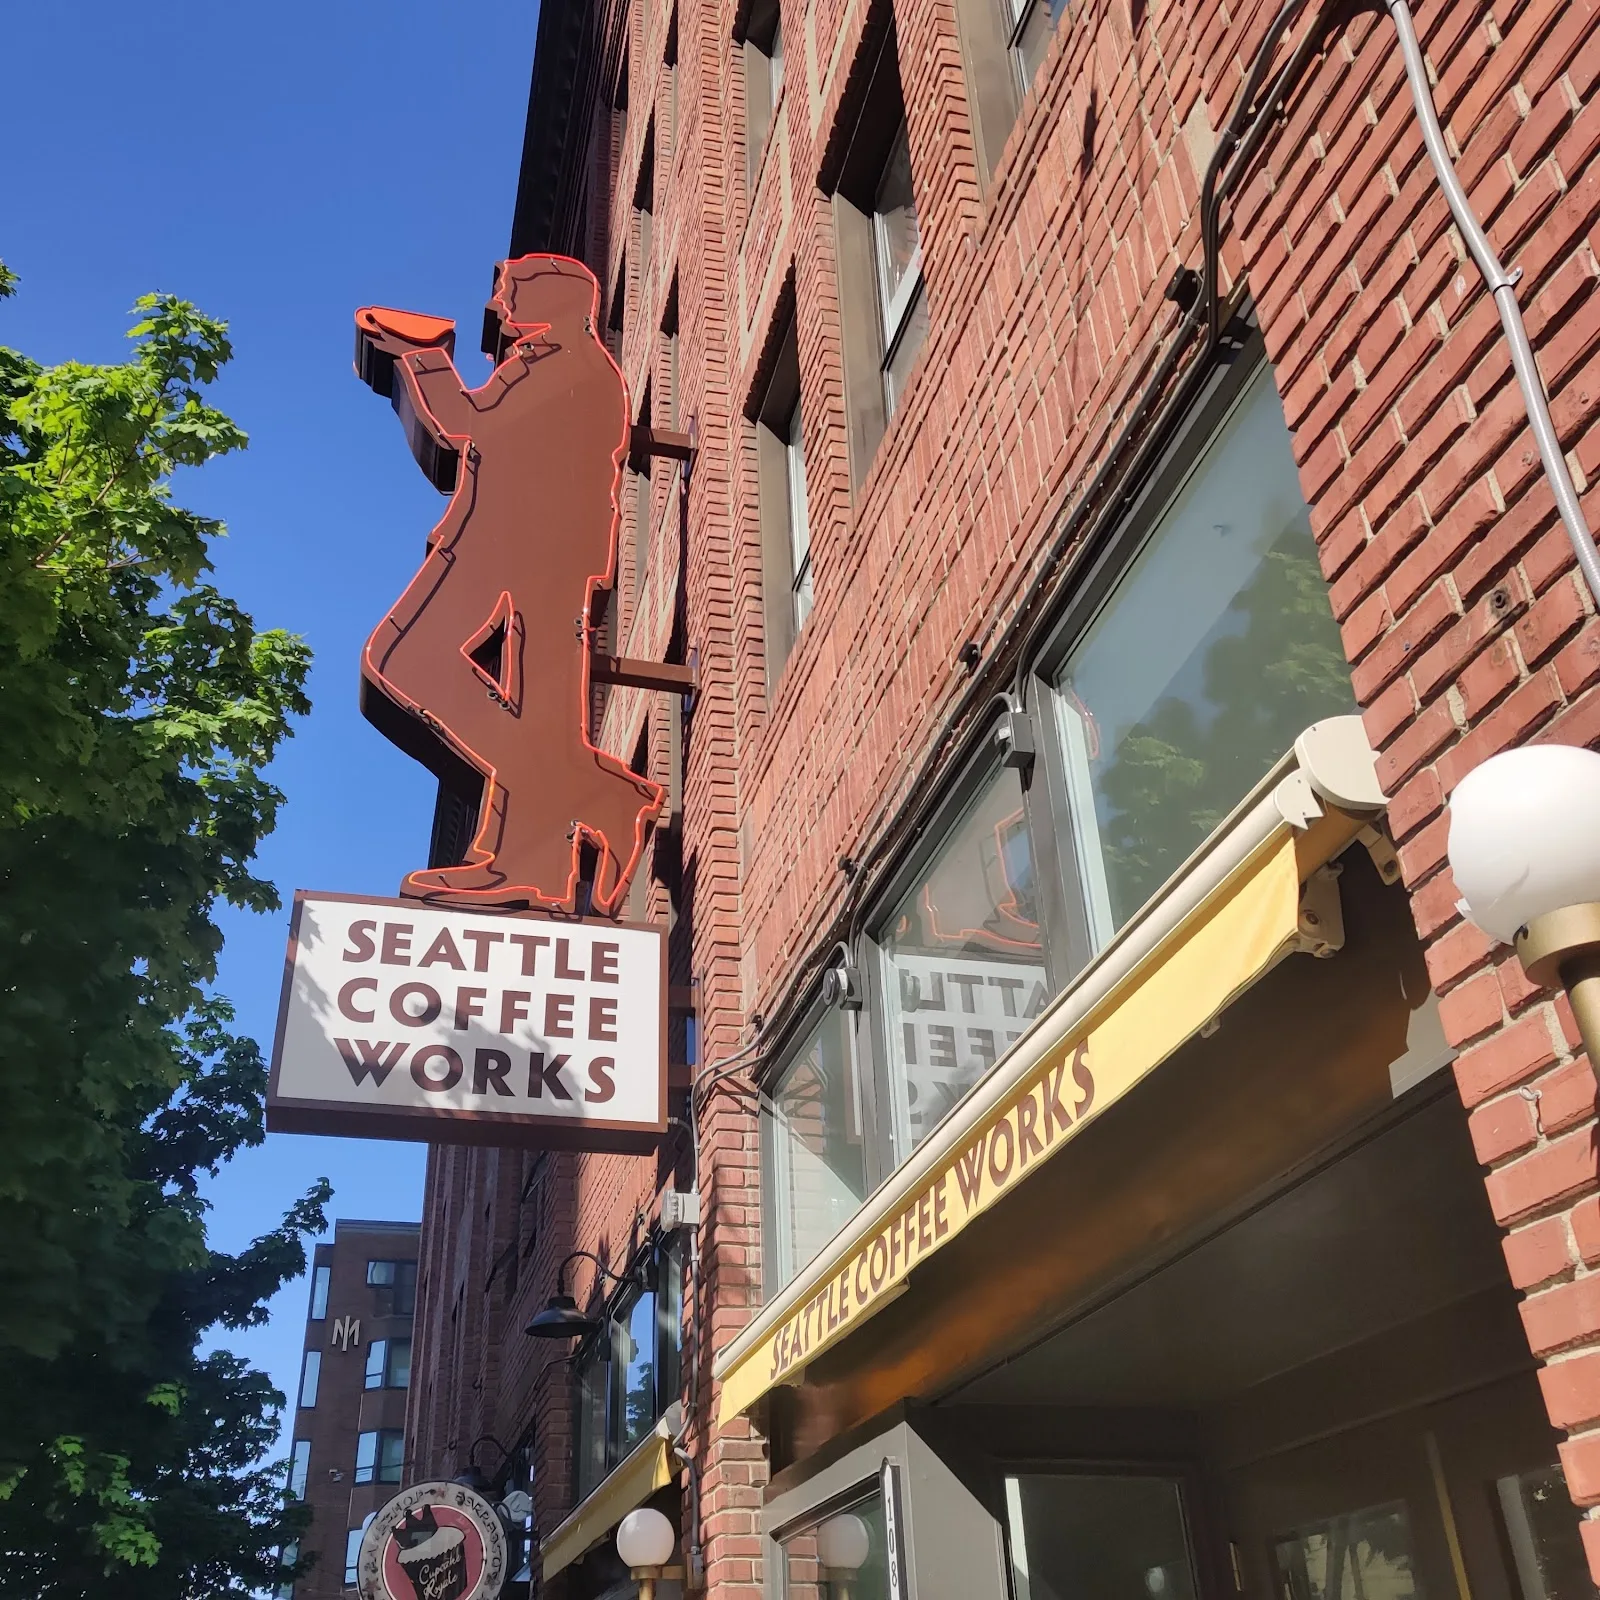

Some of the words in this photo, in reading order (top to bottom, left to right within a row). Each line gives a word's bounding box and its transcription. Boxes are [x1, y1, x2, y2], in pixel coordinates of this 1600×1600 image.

[342, 919, 620, 985] SEATTLE
[337, 977, 618, 1043] COFFEE
[333, 1037, 616, 1104] WORKS
[770, 1270, 849, 1381] SEATTLE
[855, 1171, 949, 1306] COFFEE
[953, 1037, 1095, 1214] WORKS
[418, 1546, 462, 1585] Cupcake
[886, 1496, 898, 1588] 108
[423, 1569, 459, 1600] Royale
